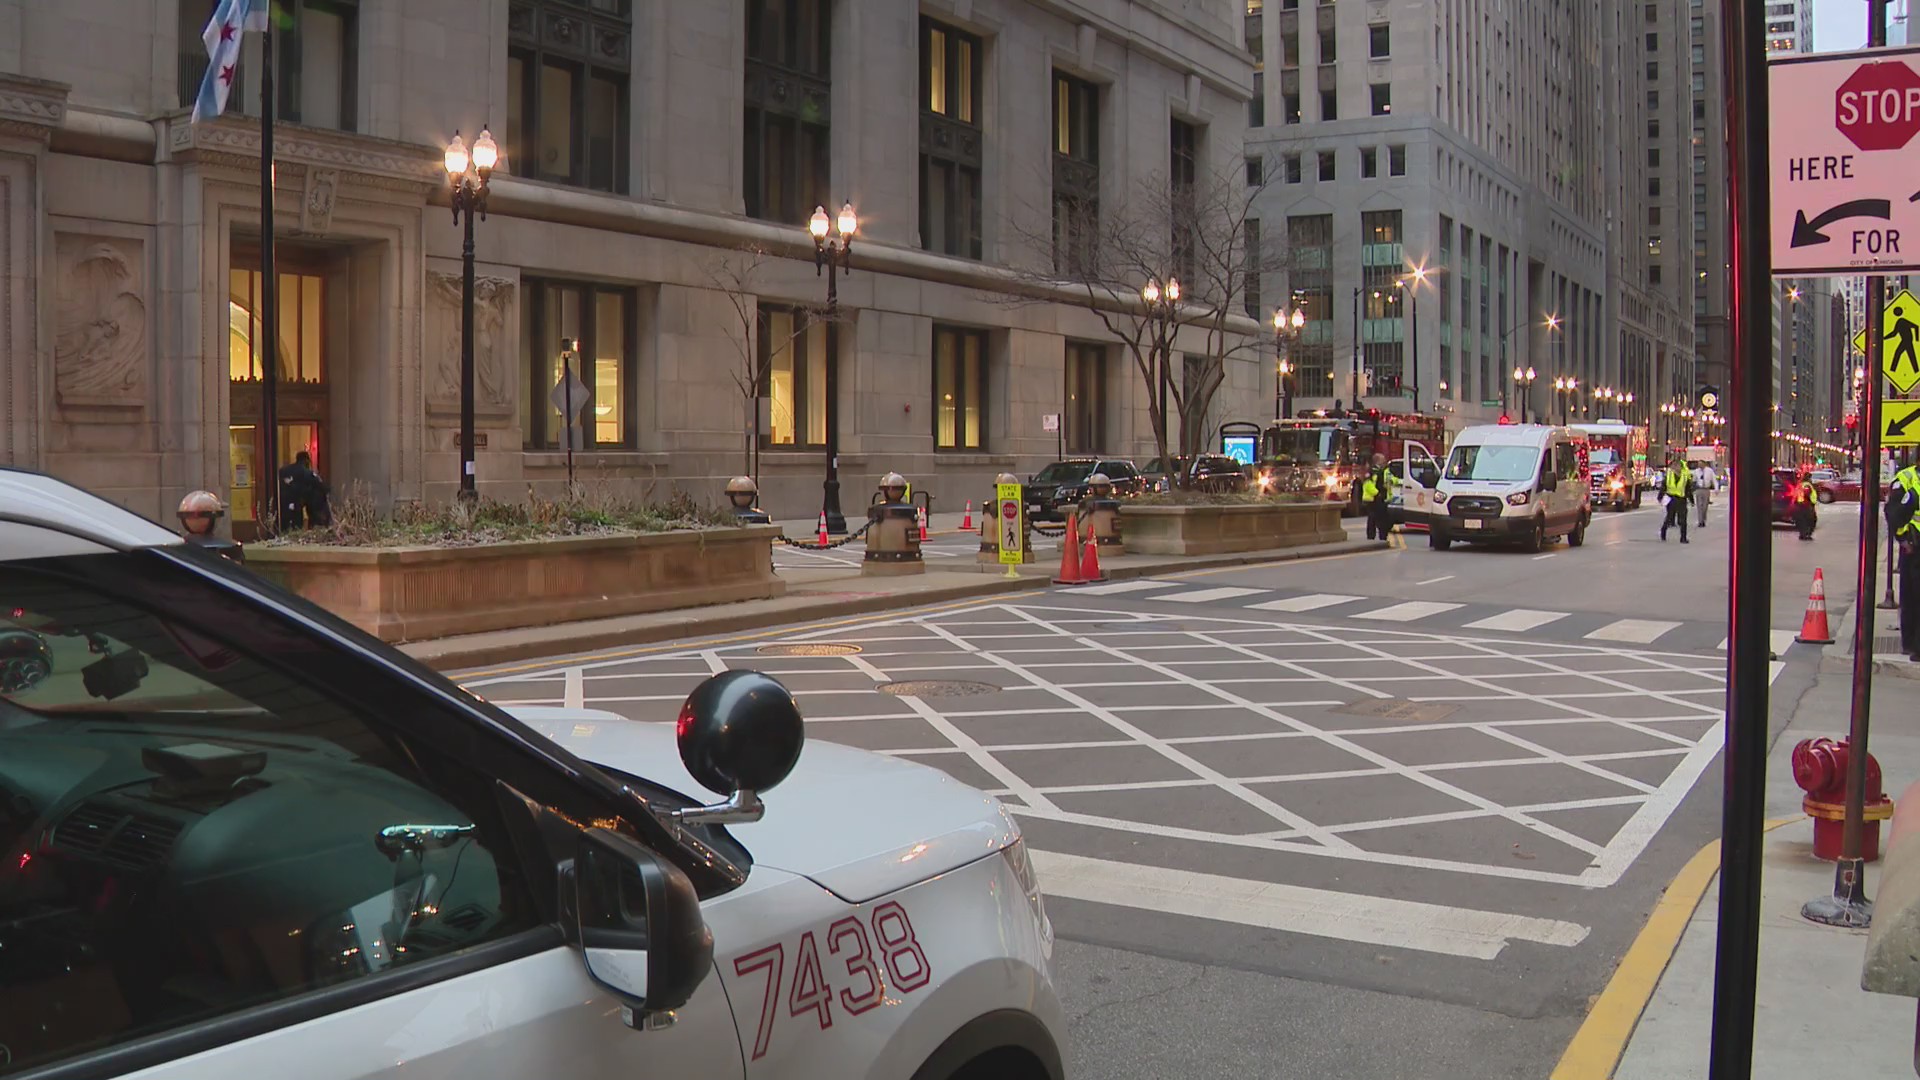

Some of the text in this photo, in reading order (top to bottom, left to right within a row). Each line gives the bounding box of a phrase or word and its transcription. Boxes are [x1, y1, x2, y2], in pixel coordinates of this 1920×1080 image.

[1840, 88, 1920, 126] STOP
[1789, 155, 1854, 182] HERE
[1852, 229, 1900, 254] FOR
[733, 900, 931, 1062] 7438
